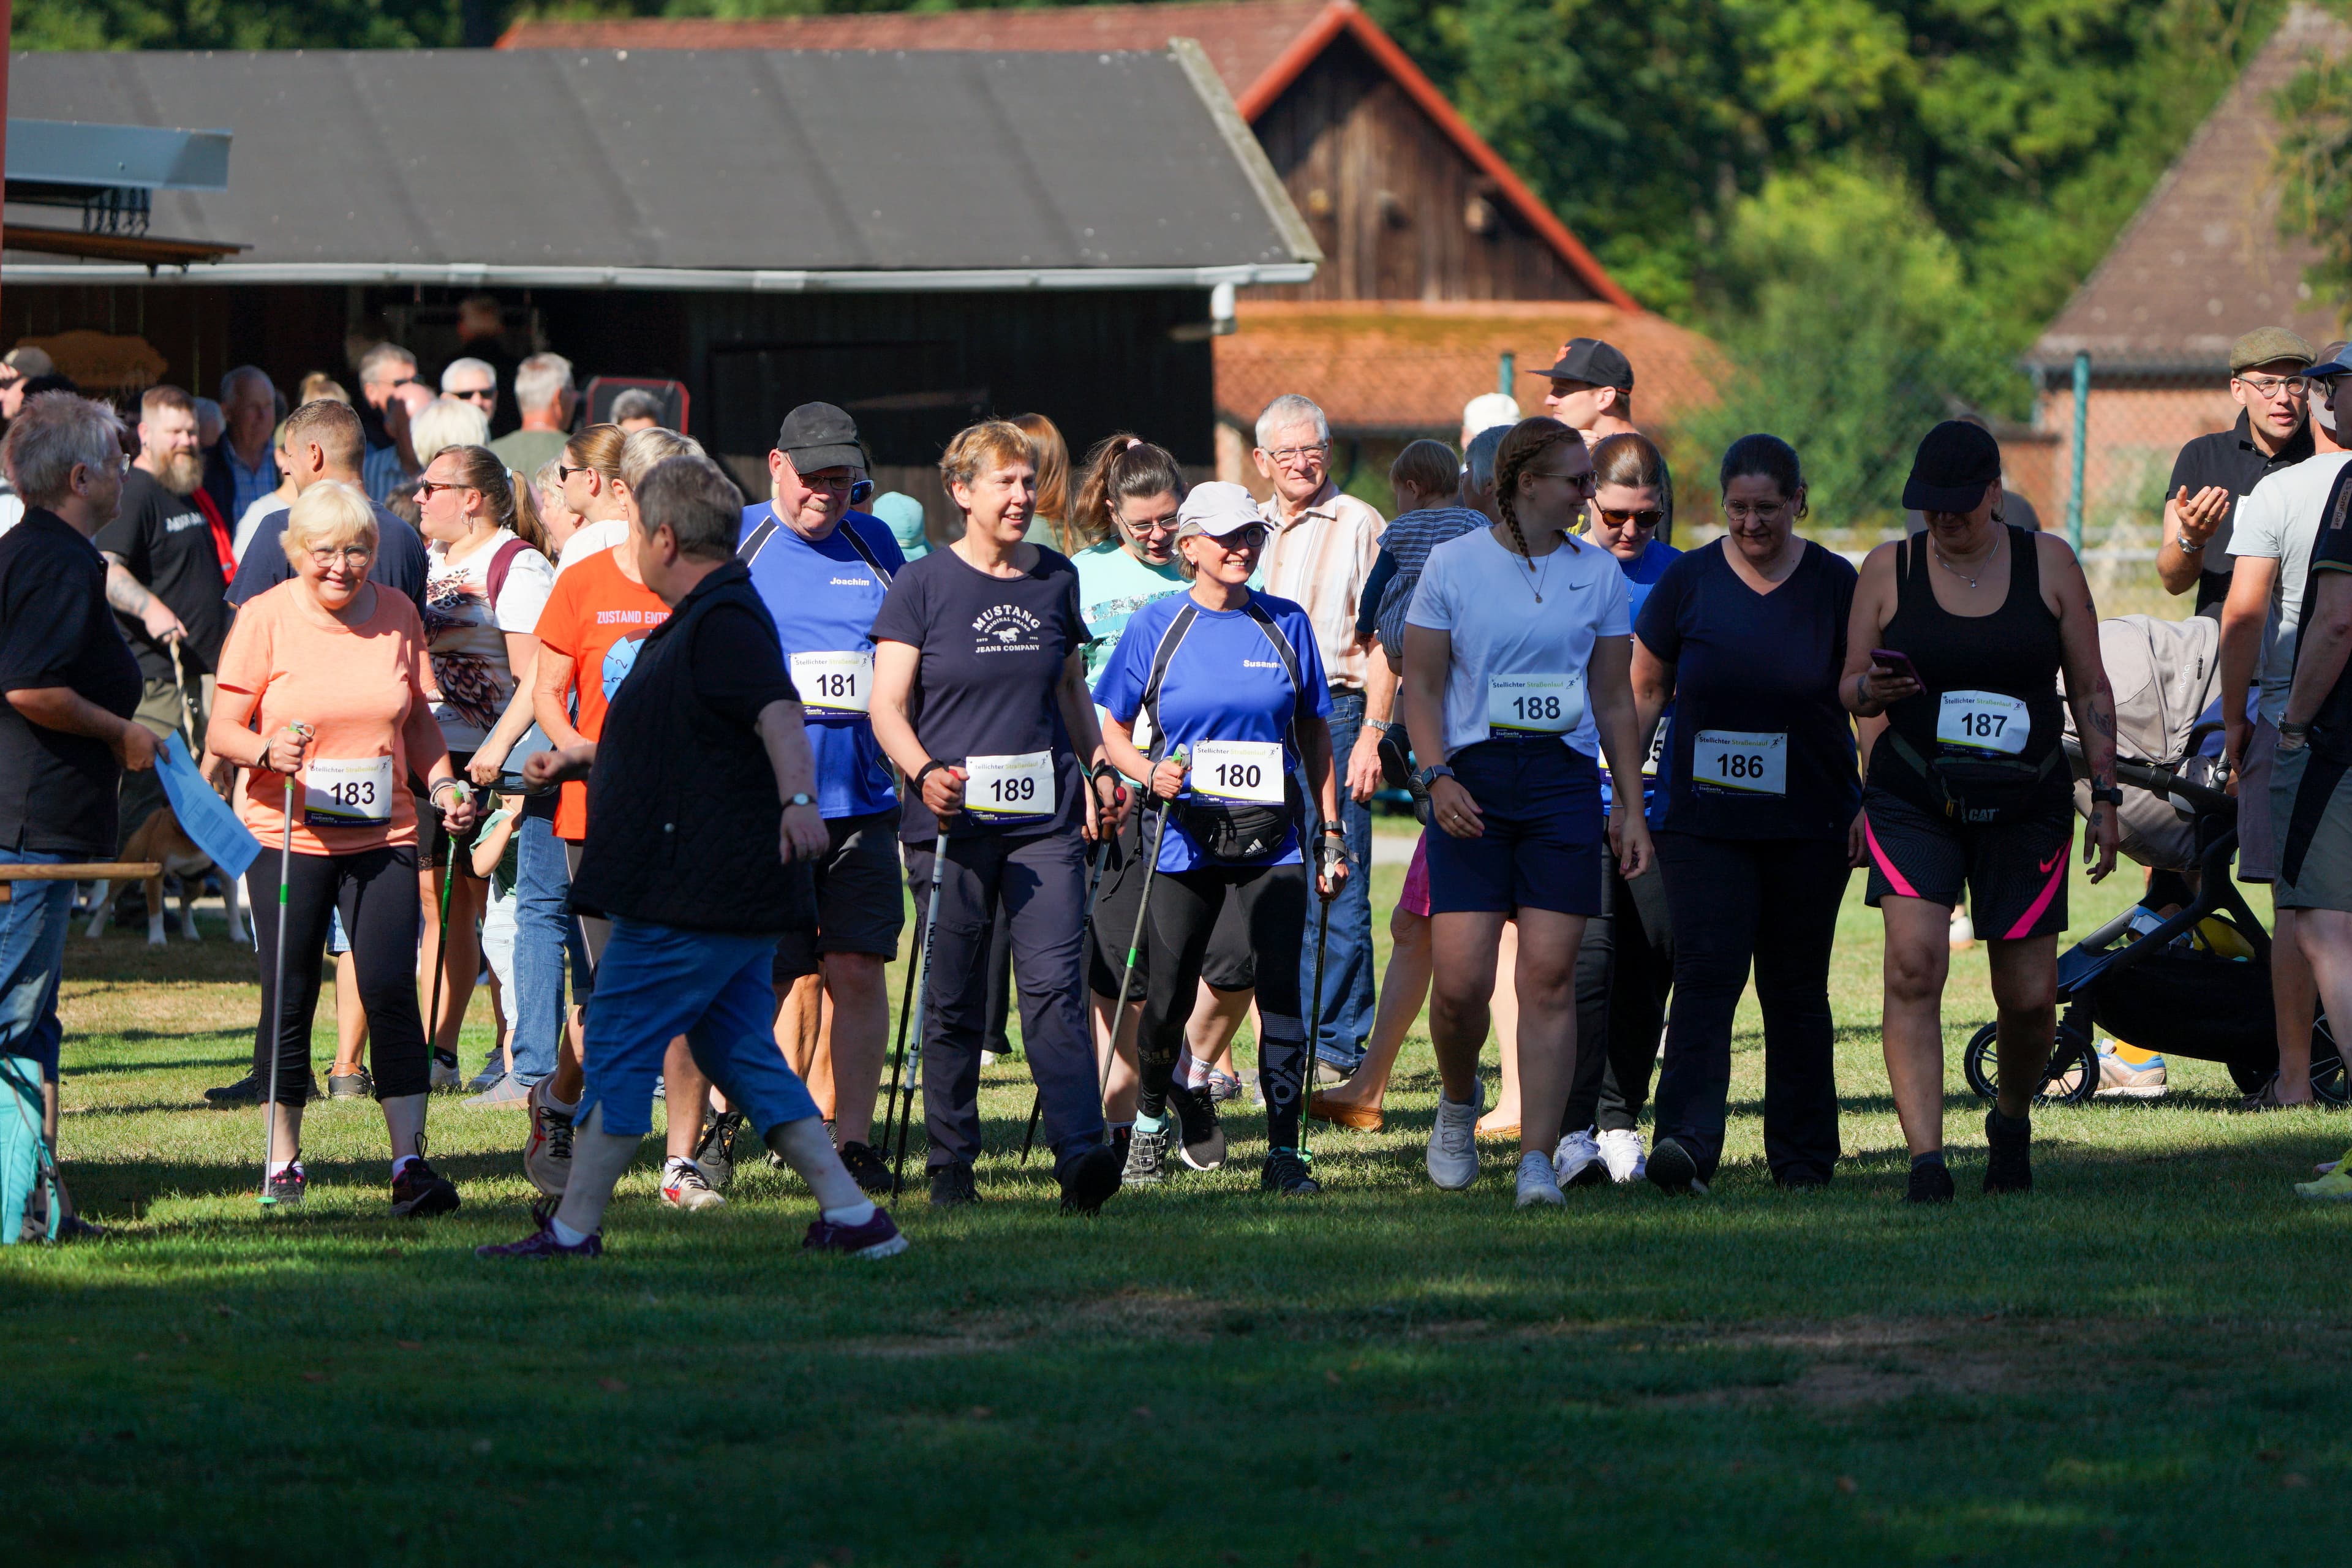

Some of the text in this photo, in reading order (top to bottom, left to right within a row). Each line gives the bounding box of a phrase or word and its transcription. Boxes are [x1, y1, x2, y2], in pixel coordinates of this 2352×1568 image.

[2334, 491, 2348, 527] sonepar
[830, 577, 870, 586] Joachim
[597, 610, 642, 624] ZUSTAND
[972, 605, 1041, 631] MUSTANG
[984, 617, 1031, 633] ORIGINAL BRAND
[975, 645, 1001, 654] JEANS
[615, 658, 628, 669] 2
[1243, 660, 1281, 668] Susanne
[816, 673, 855, 696] 181
[1513, 696, 1561, 720] 188
[1961, 712, 2008, 737] 187
[1699, 736, 1730, 745] Stellichter
[1717, 753, 1763, 778] 186
[1216, 764, 1261, 788] 180
[331, 781, 375, 805] 183
[990, 776, 1035, 802] 189
[1969, 809, 1996, 822] CAT
[1243, 848, 1268, 858] adidas
